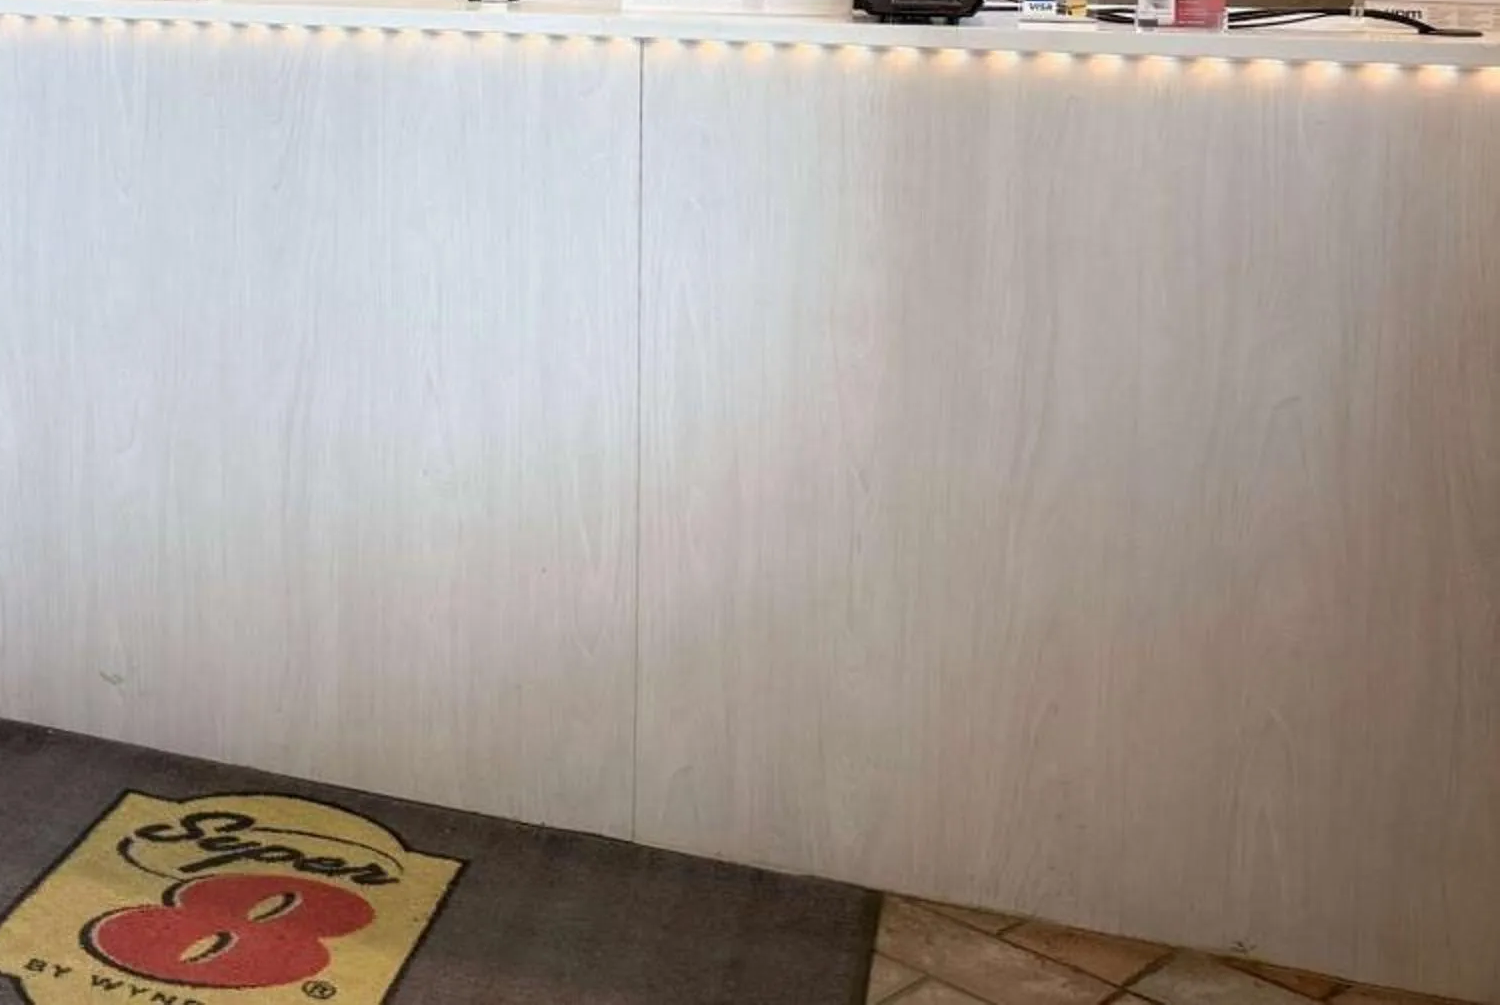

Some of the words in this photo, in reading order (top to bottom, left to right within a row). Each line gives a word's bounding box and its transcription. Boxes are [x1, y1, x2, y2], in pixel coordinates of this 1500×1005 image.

[134, 811, 400, 886] Super
[24, 958, 72, 978] BY
[79, 872, 377, 990] 8
